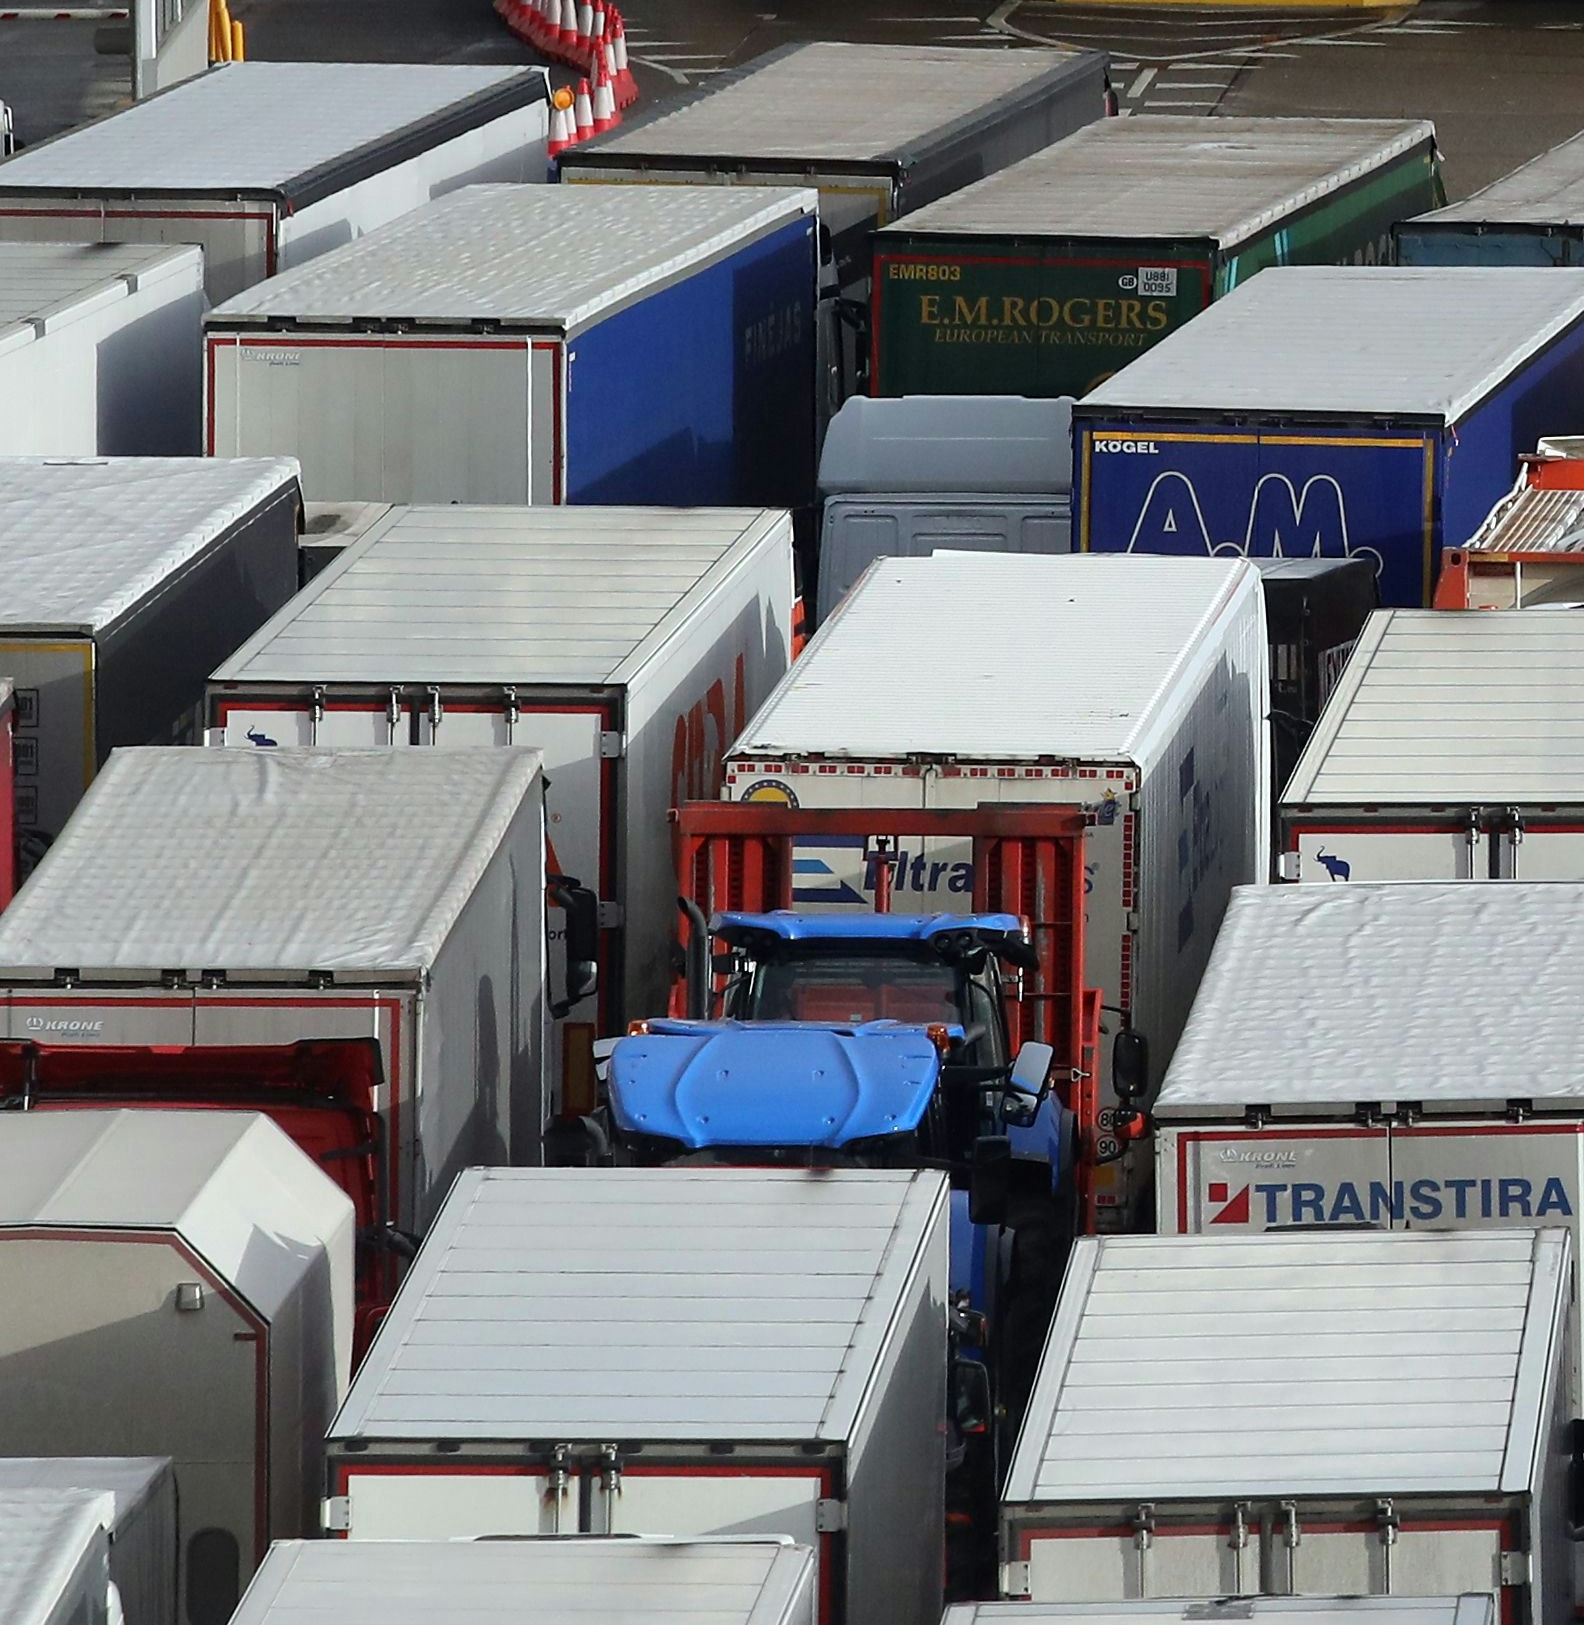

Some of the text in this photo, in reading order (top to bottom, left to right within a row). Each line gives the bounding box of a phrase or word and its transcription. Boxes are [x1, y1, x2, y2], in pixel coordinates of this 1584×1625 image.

[889, 264, 961, 281] EMR803
[1120, 277, 1135, 288] GB
[919, 295, 1168, 330] E.M.ROGERS
[934, 329, 1148, 346] EUROPEAN TRANSPORT
[1094, 439, 1160, 454] KÖGEL
[45, 1021, 104, 1031] KRONE
[1099, 1140, 1117, 1155] 90
[1254, 1176, 1573, 1224] TRANSTIRA
